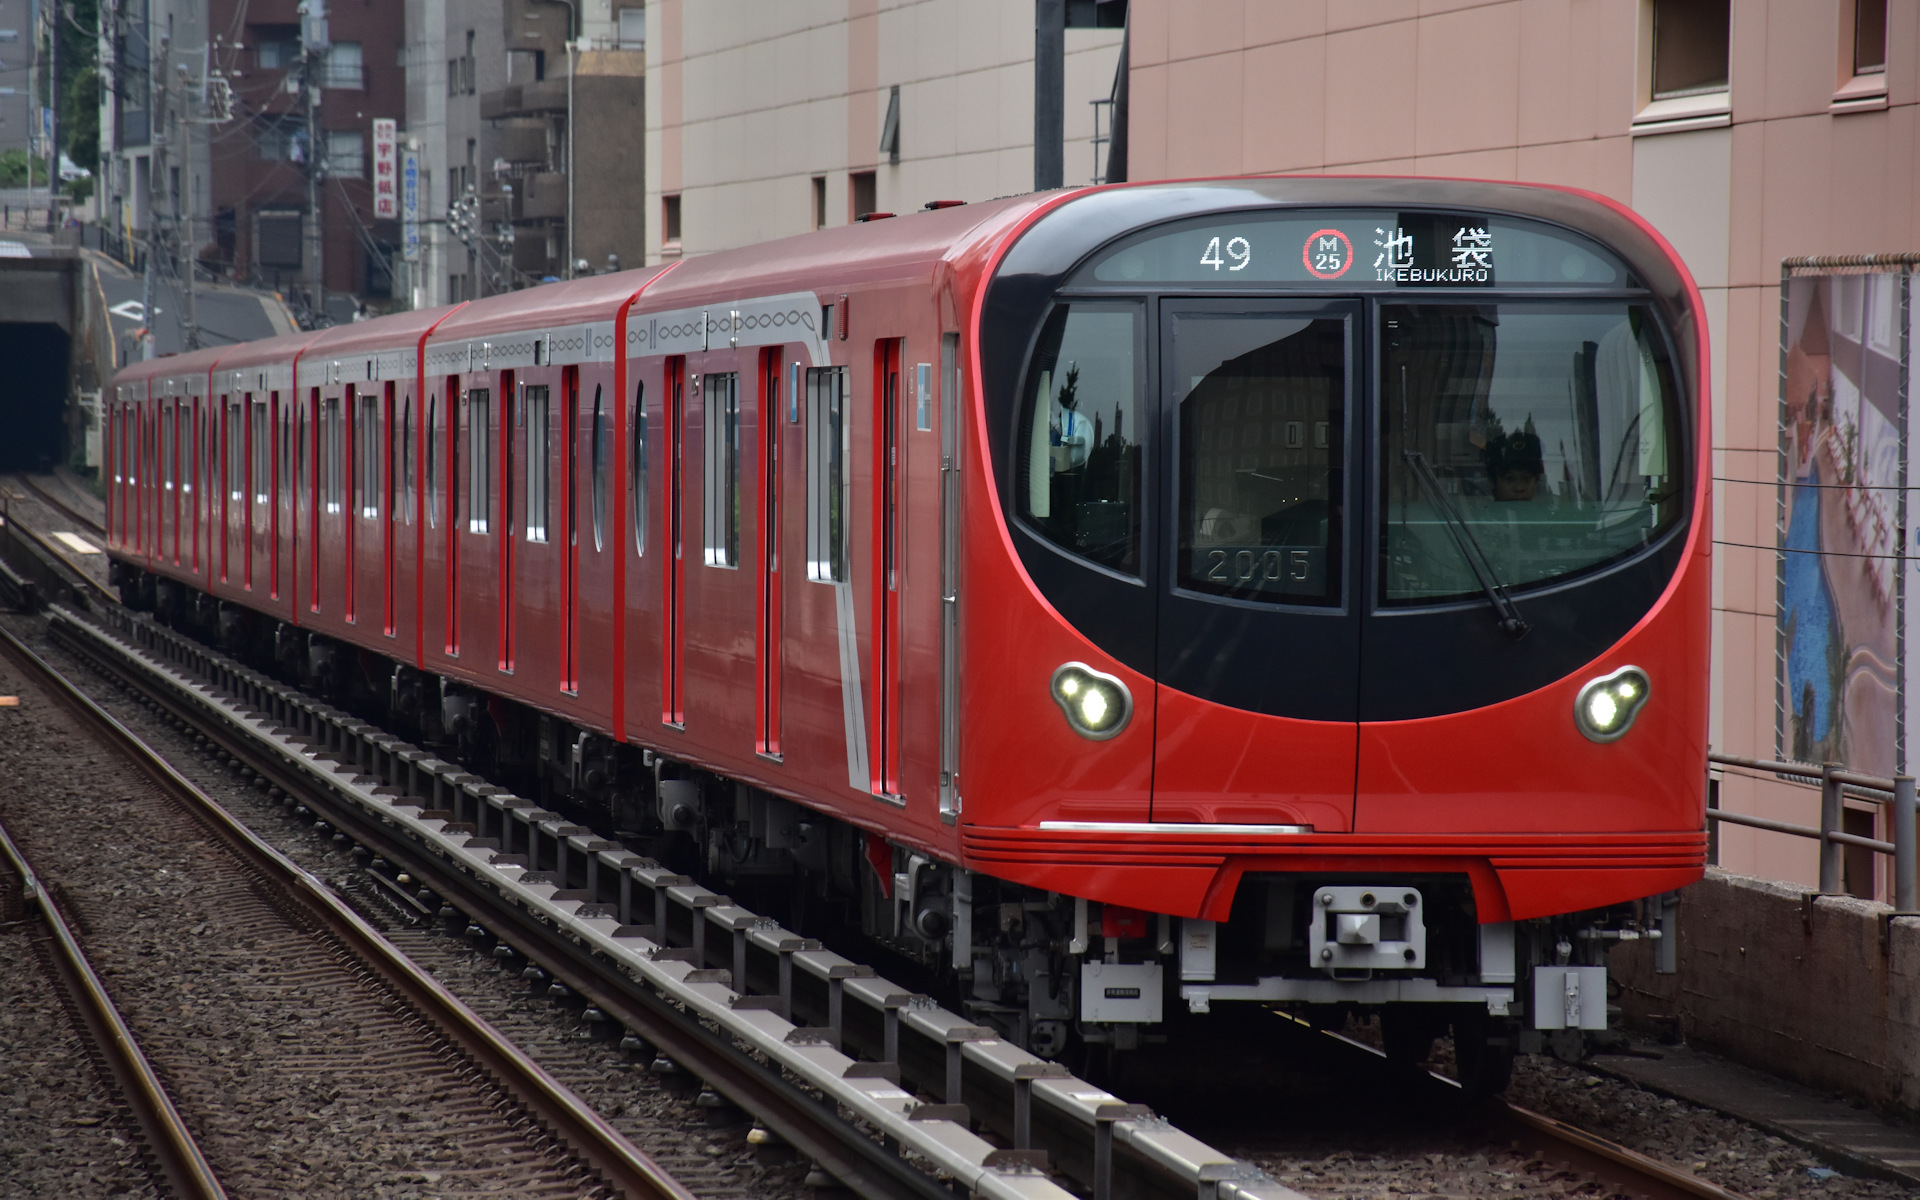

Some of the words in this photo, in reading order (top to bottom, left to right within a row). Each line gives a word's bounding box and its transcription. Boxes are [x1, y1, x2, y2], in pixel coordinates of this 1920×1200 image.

[1199, 236, 1251, 271] 49
[1319, 236, 1338, 252] M
[1373, 227, 1493, 268] 池袋
[1315, 253, 1342, 270] 25
[1375, 268, 1488, 282] IKEBUKURO
[1207, 550, 1310, 582] 2005
